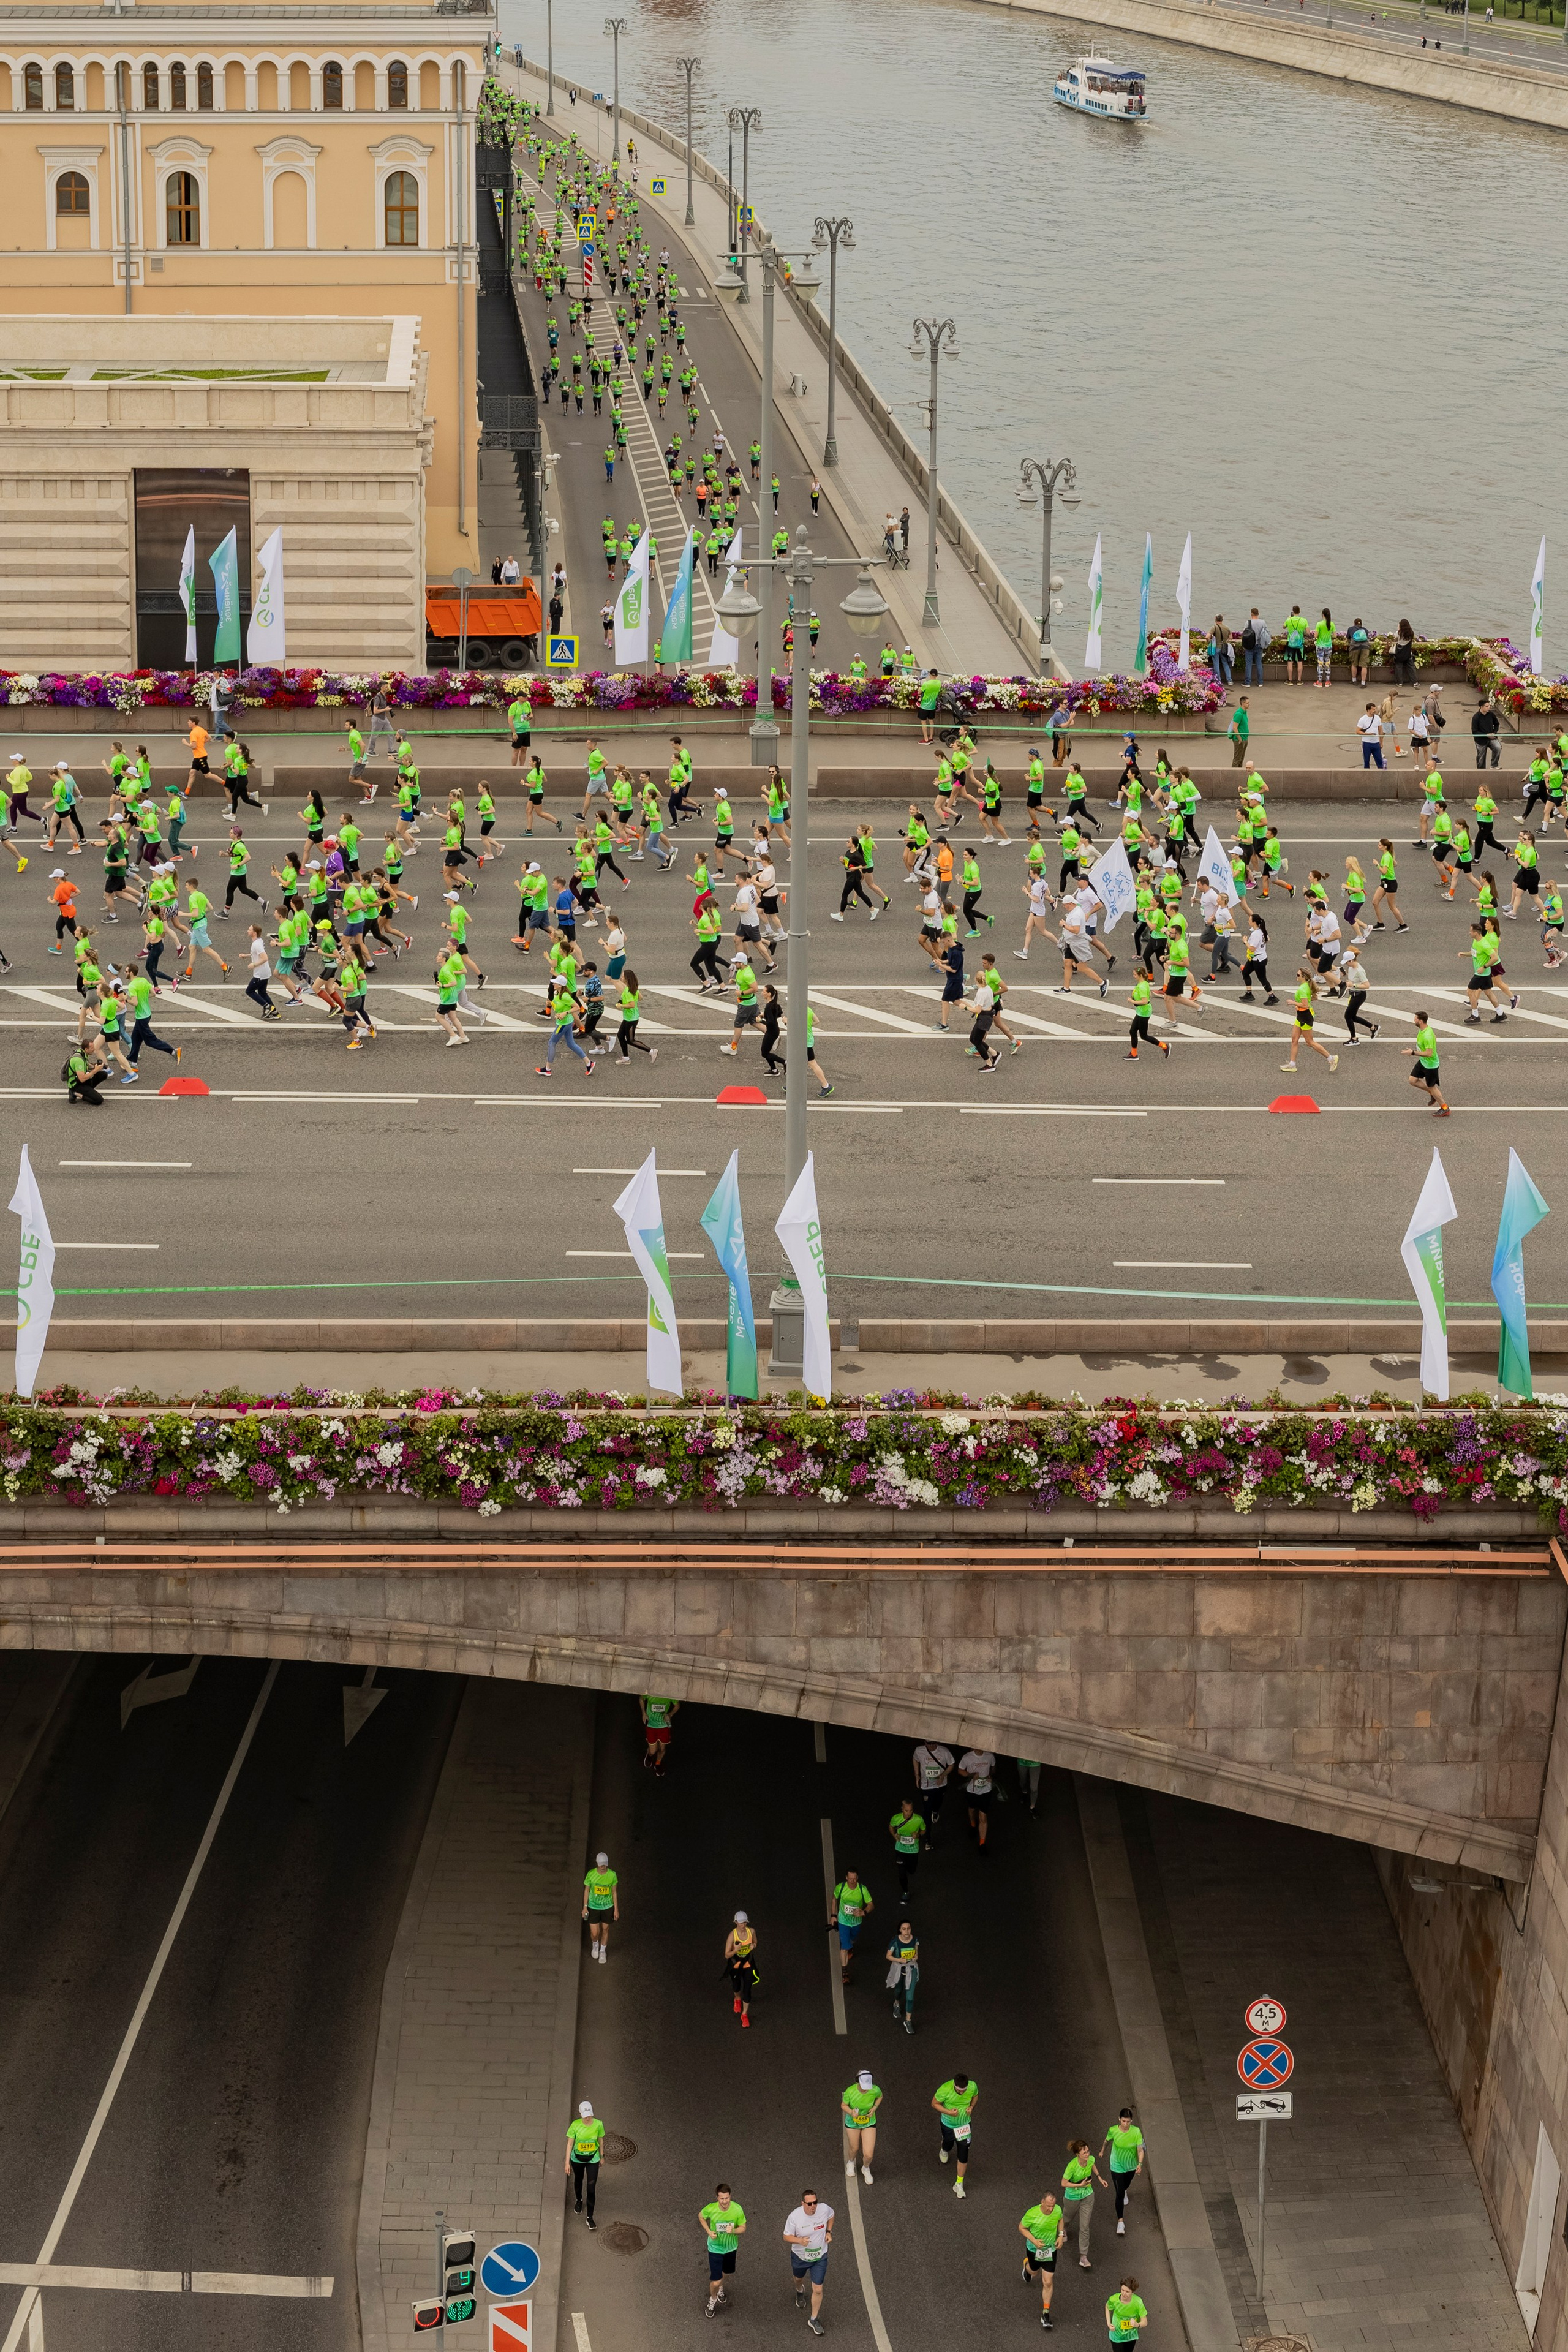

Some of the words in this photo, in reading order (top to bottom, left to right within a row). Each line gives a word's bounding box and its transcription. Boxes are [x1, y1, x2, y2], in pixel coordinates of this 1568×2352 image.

[18, 1232, 40, 1289] СБЕ
[1254, 2007, 1276, 2019] 4,5
[956, 2127, 969, 2135] 1040
